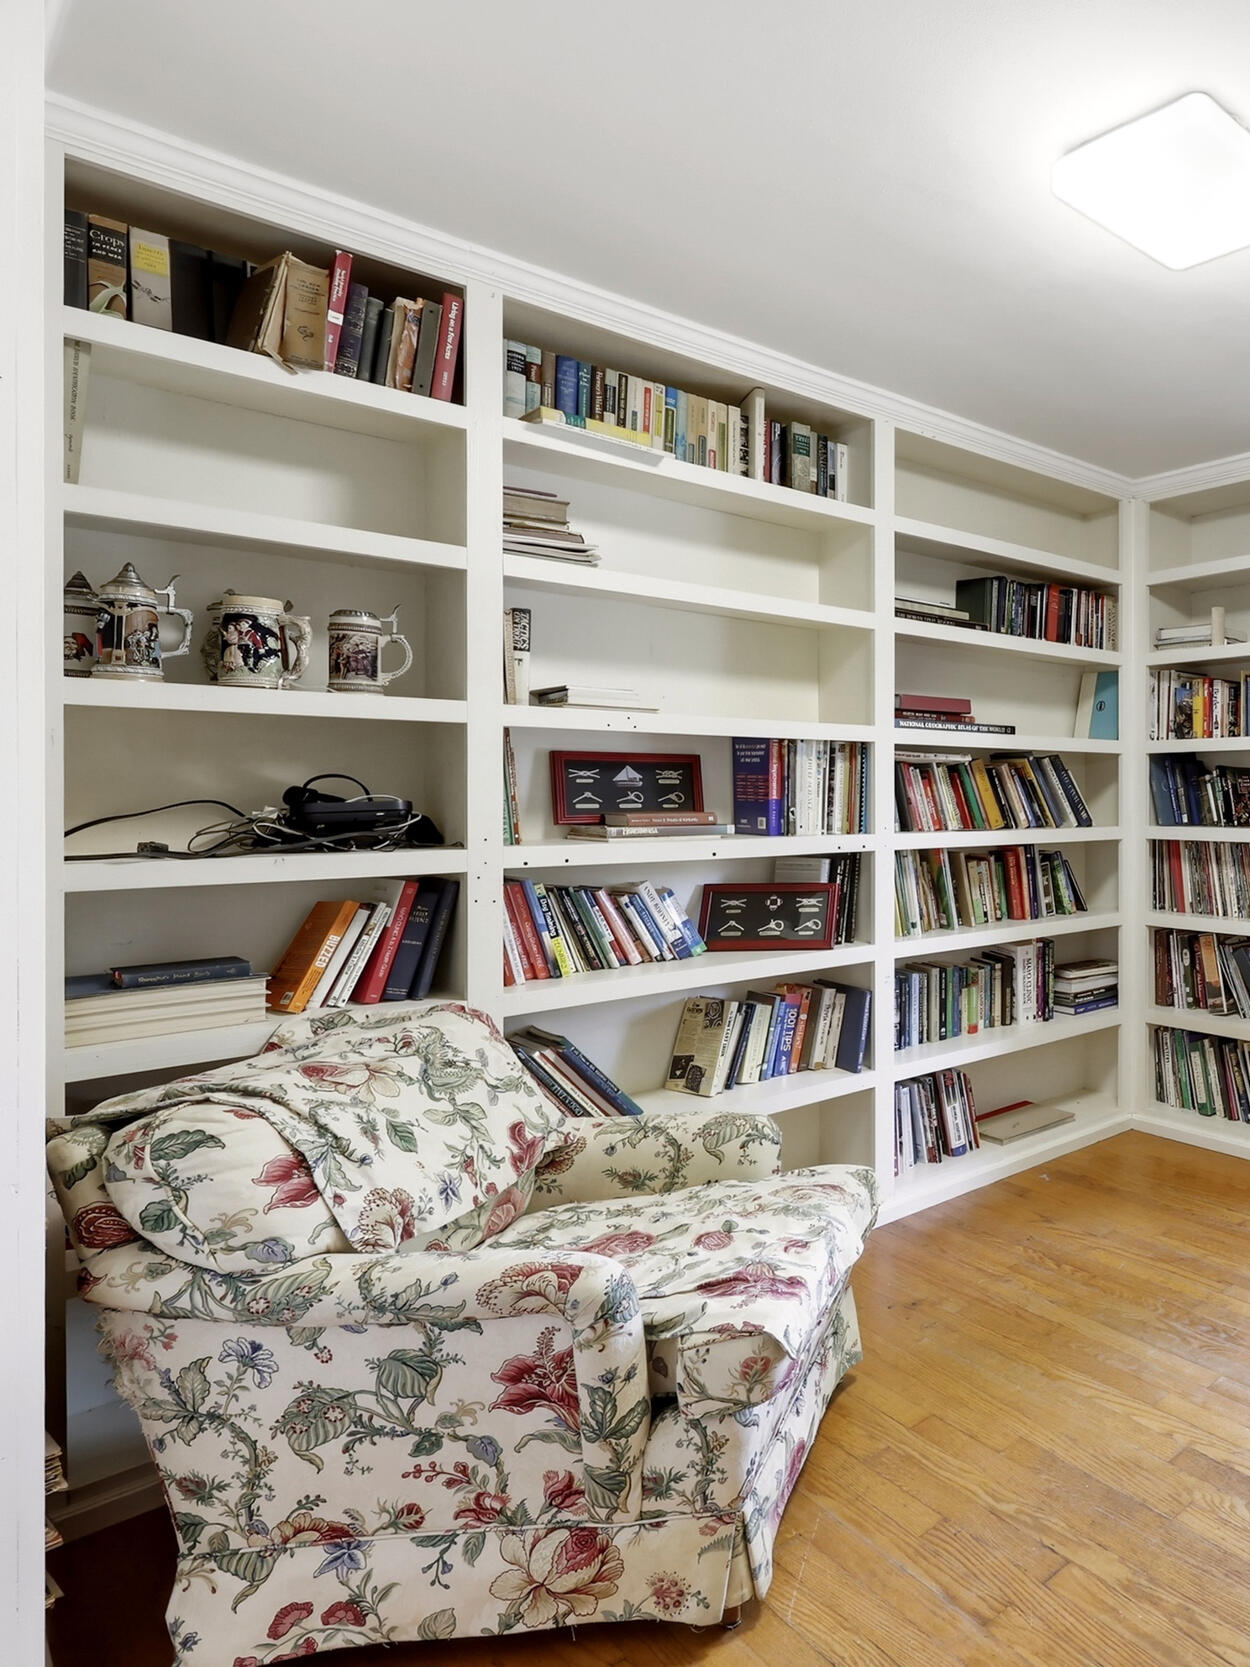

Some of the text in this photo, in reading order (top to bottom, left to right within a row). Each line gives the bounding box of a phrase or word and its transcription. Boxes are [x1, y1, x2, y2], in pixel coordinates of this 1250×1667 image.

[89, 229, 126, 248] Crops
[449, 302, 459, 318] Living
[443, 342, 452, 360] Acres
[519, 611, 529, 649] TACTICS
[898, 720, 924, 728] NATIONAL
[924, 721, 957, 730] GEOGRAPHIC
[957, 723, 971, 731] ATLAS
[540, 898, 557, 936] Dog Training
[314, 933, 341, 970] BUZZED
[781, 1006, 798, 1052] 1001 TIPS
